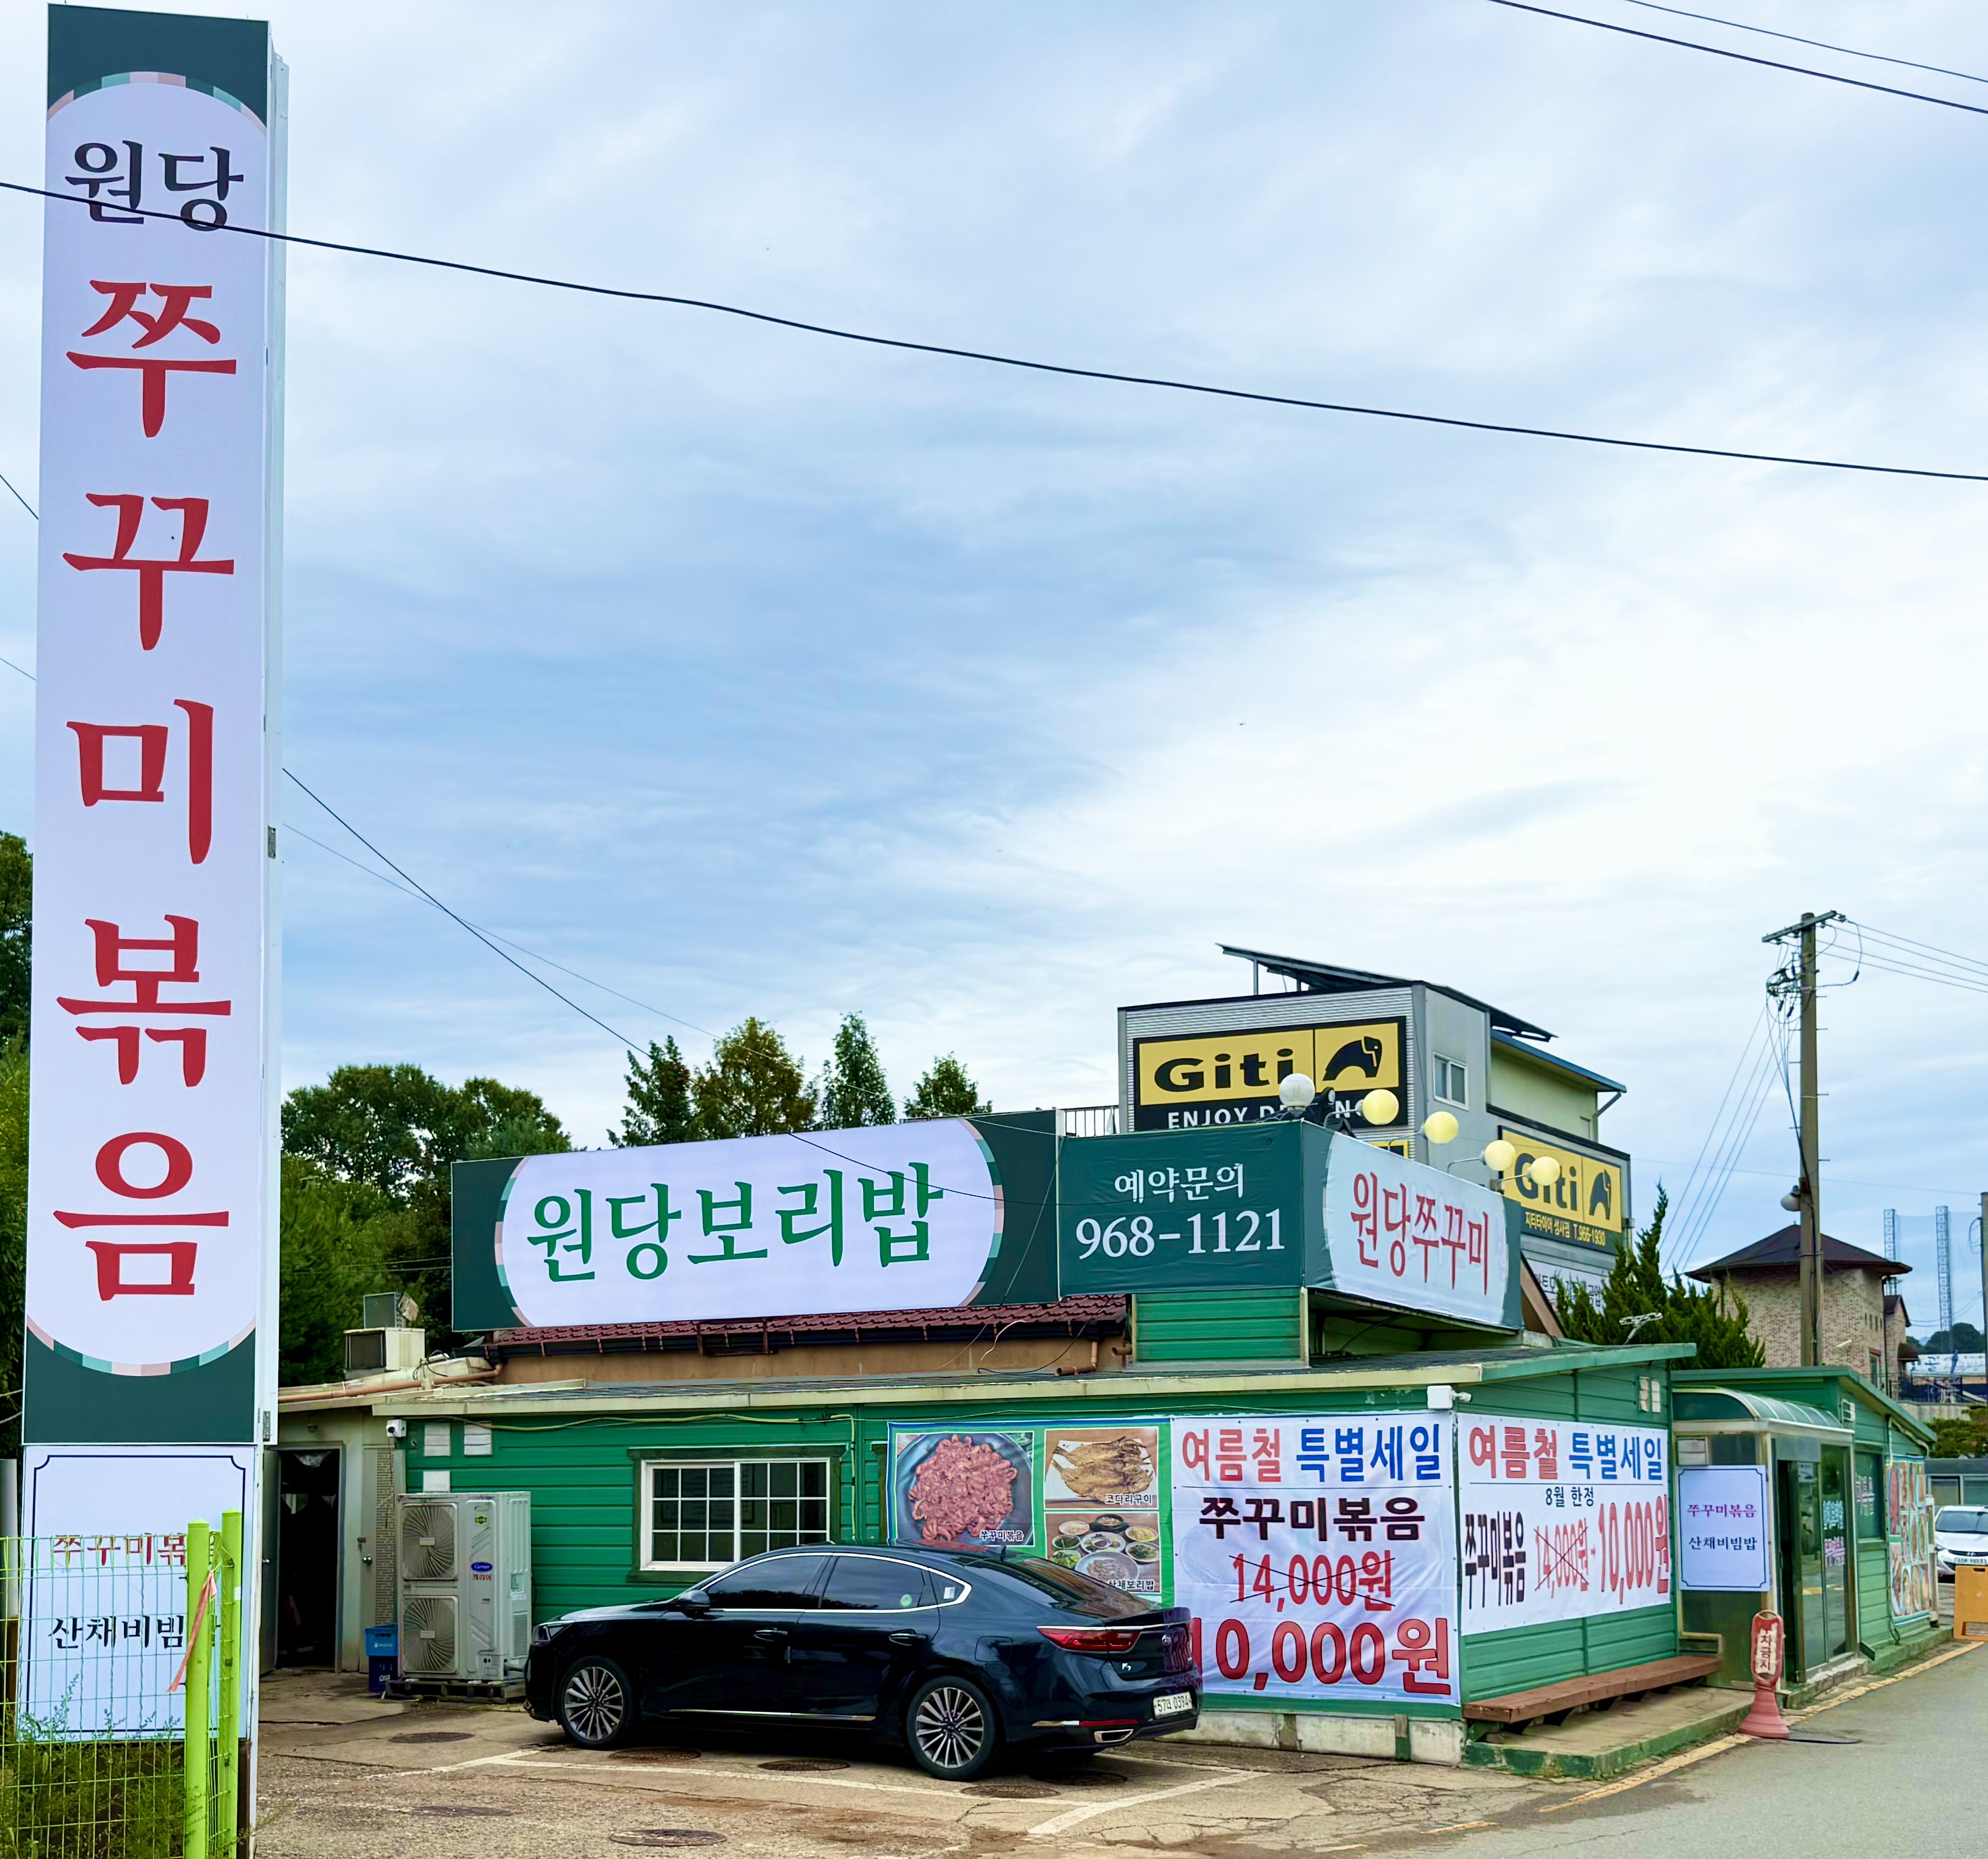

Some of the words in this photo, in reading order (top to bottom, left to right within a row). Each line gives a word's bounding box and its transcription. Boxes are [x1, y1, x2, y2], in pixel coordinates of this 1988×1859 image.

[65, 140, 244, 232] 원당
[53, 280, 237, 1301] 쭈꾸미볶음
[1154, 1048, 1293, 1092] Giti
[1168, 1106, 1248, 1129] ENJOY
[1115, 1163, 1244, 1204] 예약문의
[527, 1161, 944, 1283] 원당보리밥
[1075, 1208, 1285, 1260] 968-1121
[1182, 1428, 1282, 1483] 여름철
[1296, 1423, 1442, 1482] 특별세일
[1469, 1425, 1558, 1479] 여름철
[1569, 1432, 1663, 1481] 특별세일
[1199, 1496, 1425, 1542] 쭈꾸미볶음
[1545, 1487, 1565, 1507] 8월
[1571, 1487, 1594, 1507] 한정
[1686, 1504, 1757, 1518] 쭈꾸미볶음
[53, 1533, 215, 1567] 쭈꾸미볶
[1465, 1511, 1527, 1610] 쭈꾸미볶음
[1535, 1517, 1589, 1599] 14,000원
[1598, 1493, 1669, 1605] 10,000원
[1688, 1536, 1758, 1551] 산채비빔밥
[1232, 1550, 1392, 1613] 14,000원
[48, 1615, 221, 1649] 산채비빔
[1190, 1617, 1451, 1696] 10,000원
[1760, 1628, 1773, 1670] 차금지
